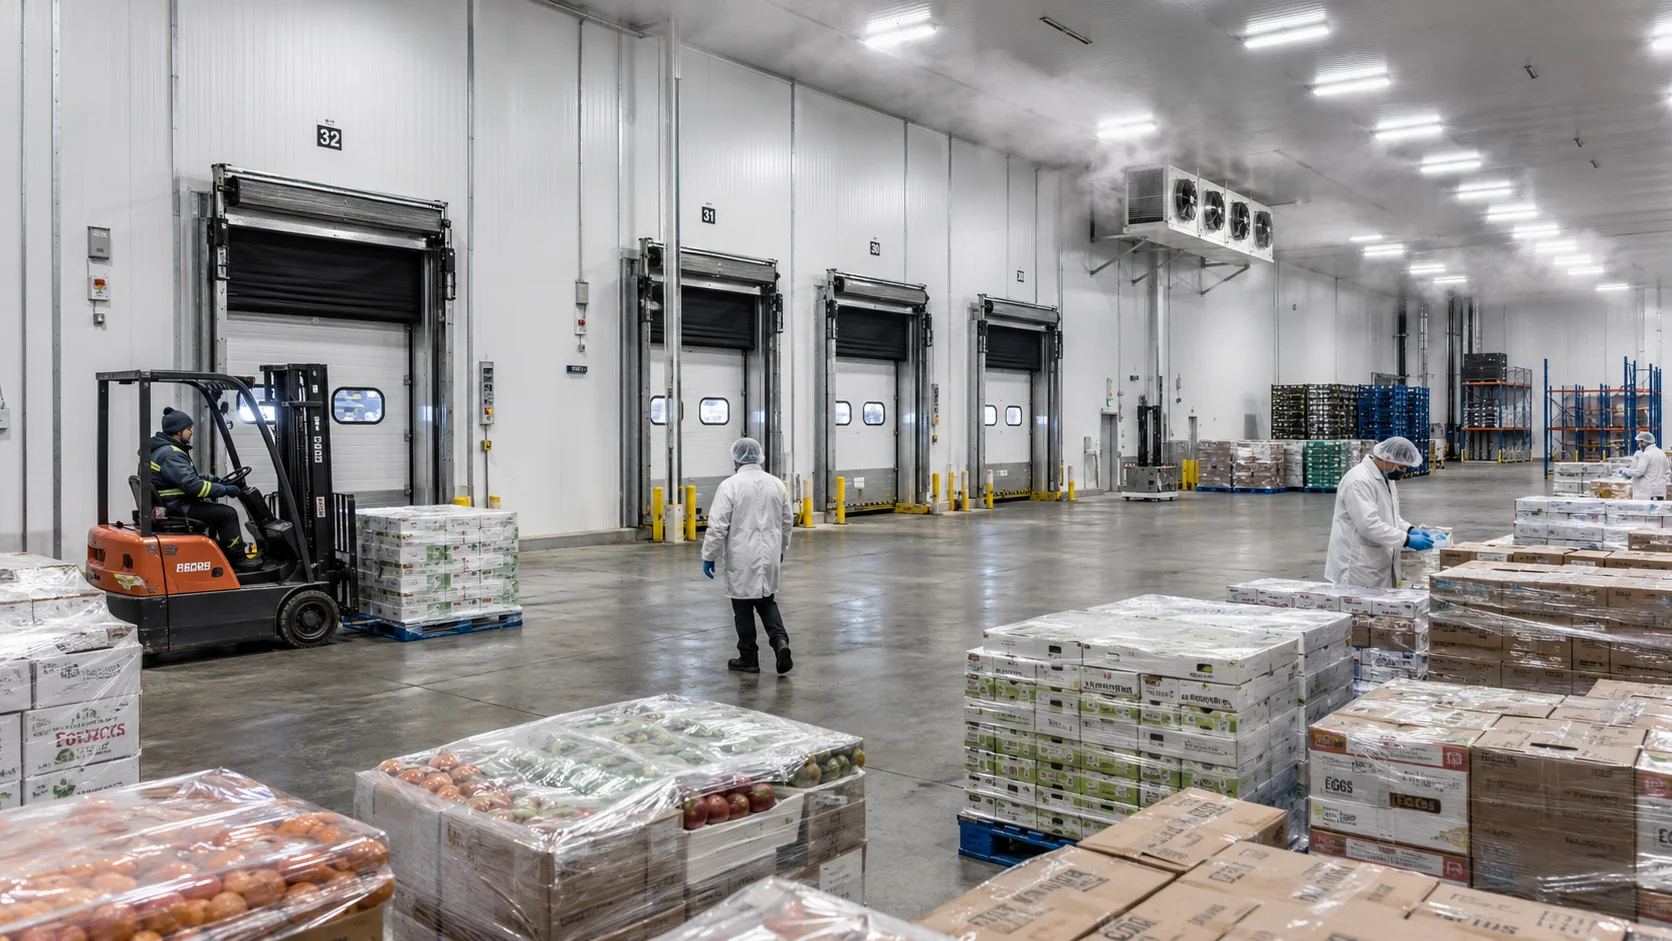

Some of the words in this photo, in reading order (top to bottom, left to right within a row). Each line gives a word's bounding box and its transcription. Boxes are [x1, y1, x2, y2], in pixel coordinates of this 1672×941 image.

[320, 128, 340, 147] 32
[703, 209, 714, 222] 31
[1325, 776, 1353, 794] EGGS
